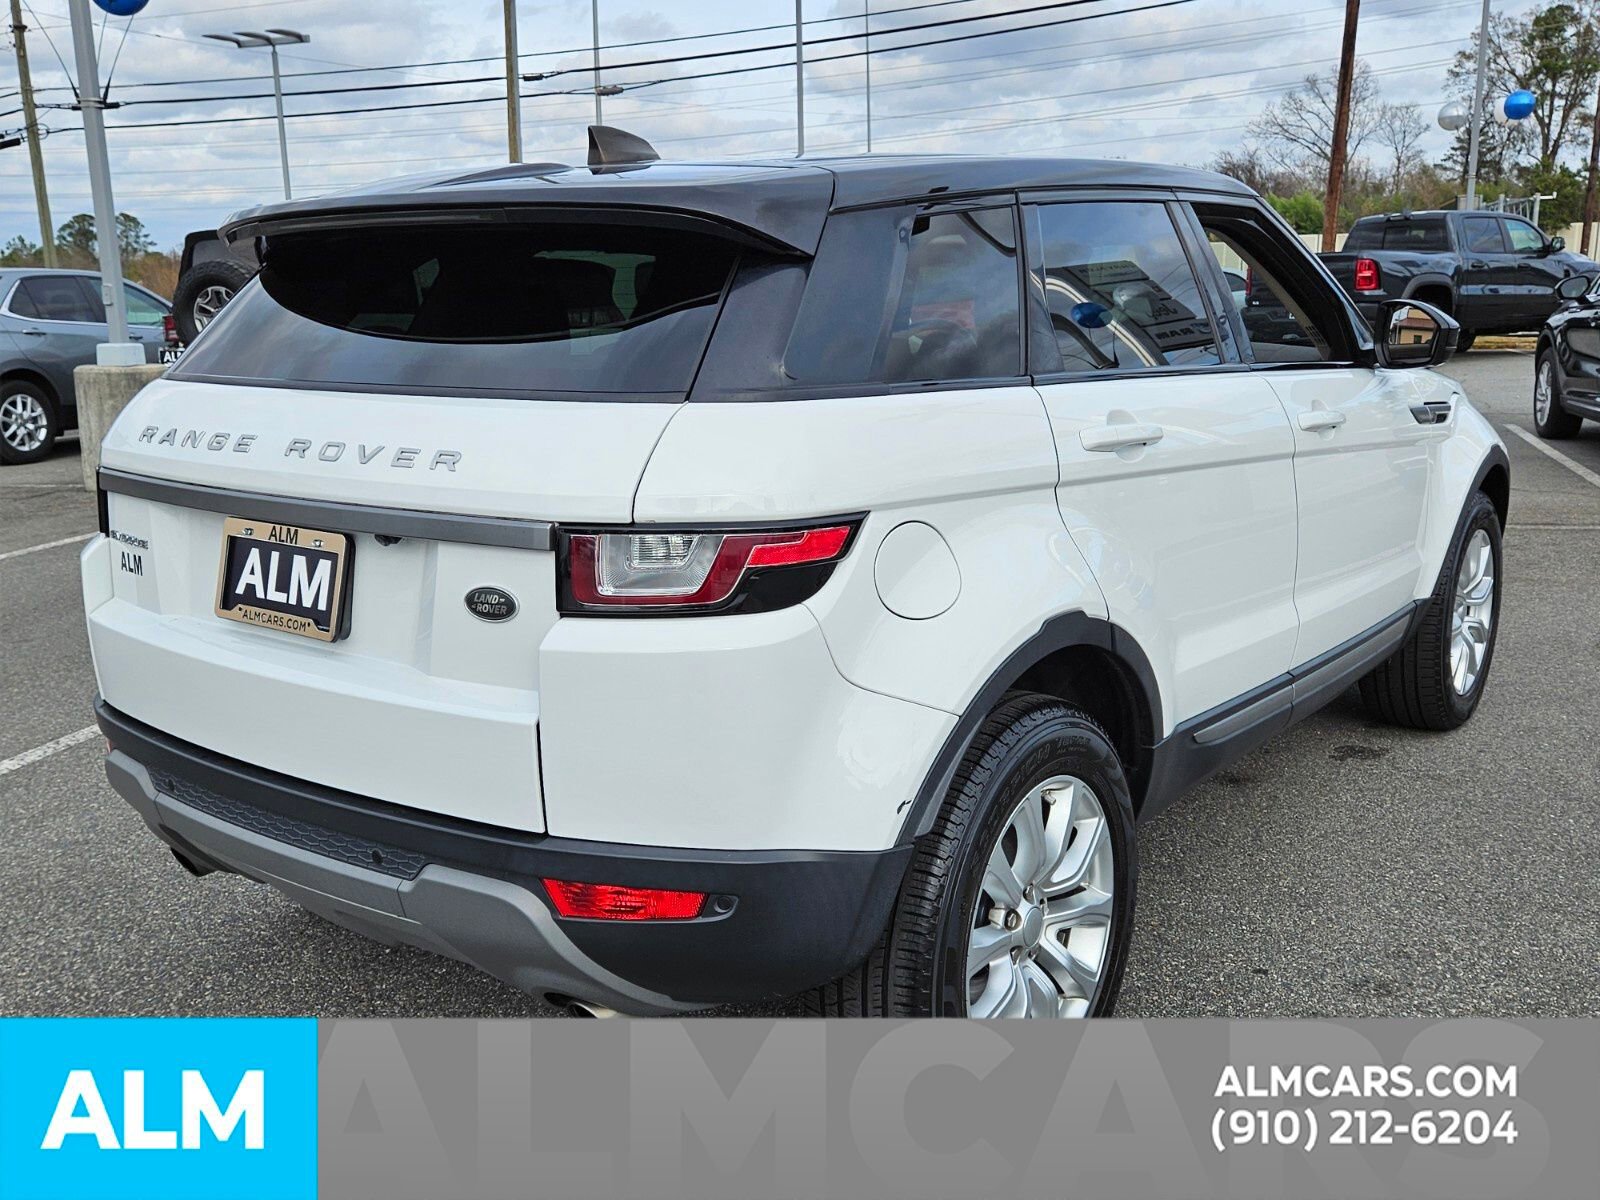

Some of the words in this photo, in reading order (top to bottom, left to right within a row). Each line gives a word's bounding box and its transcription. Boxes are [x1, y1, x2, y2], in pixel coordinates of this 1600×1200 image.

[139, 425, 258, 453] RANGE
[284, 438, 463, 472] ROVER
[268, 525, 299, 545] ALM
[121, 551, 144, 577] ALM
[234, 547, 333, 612] ALM
[241, 608, 307, 632] ALMCARS.COM
